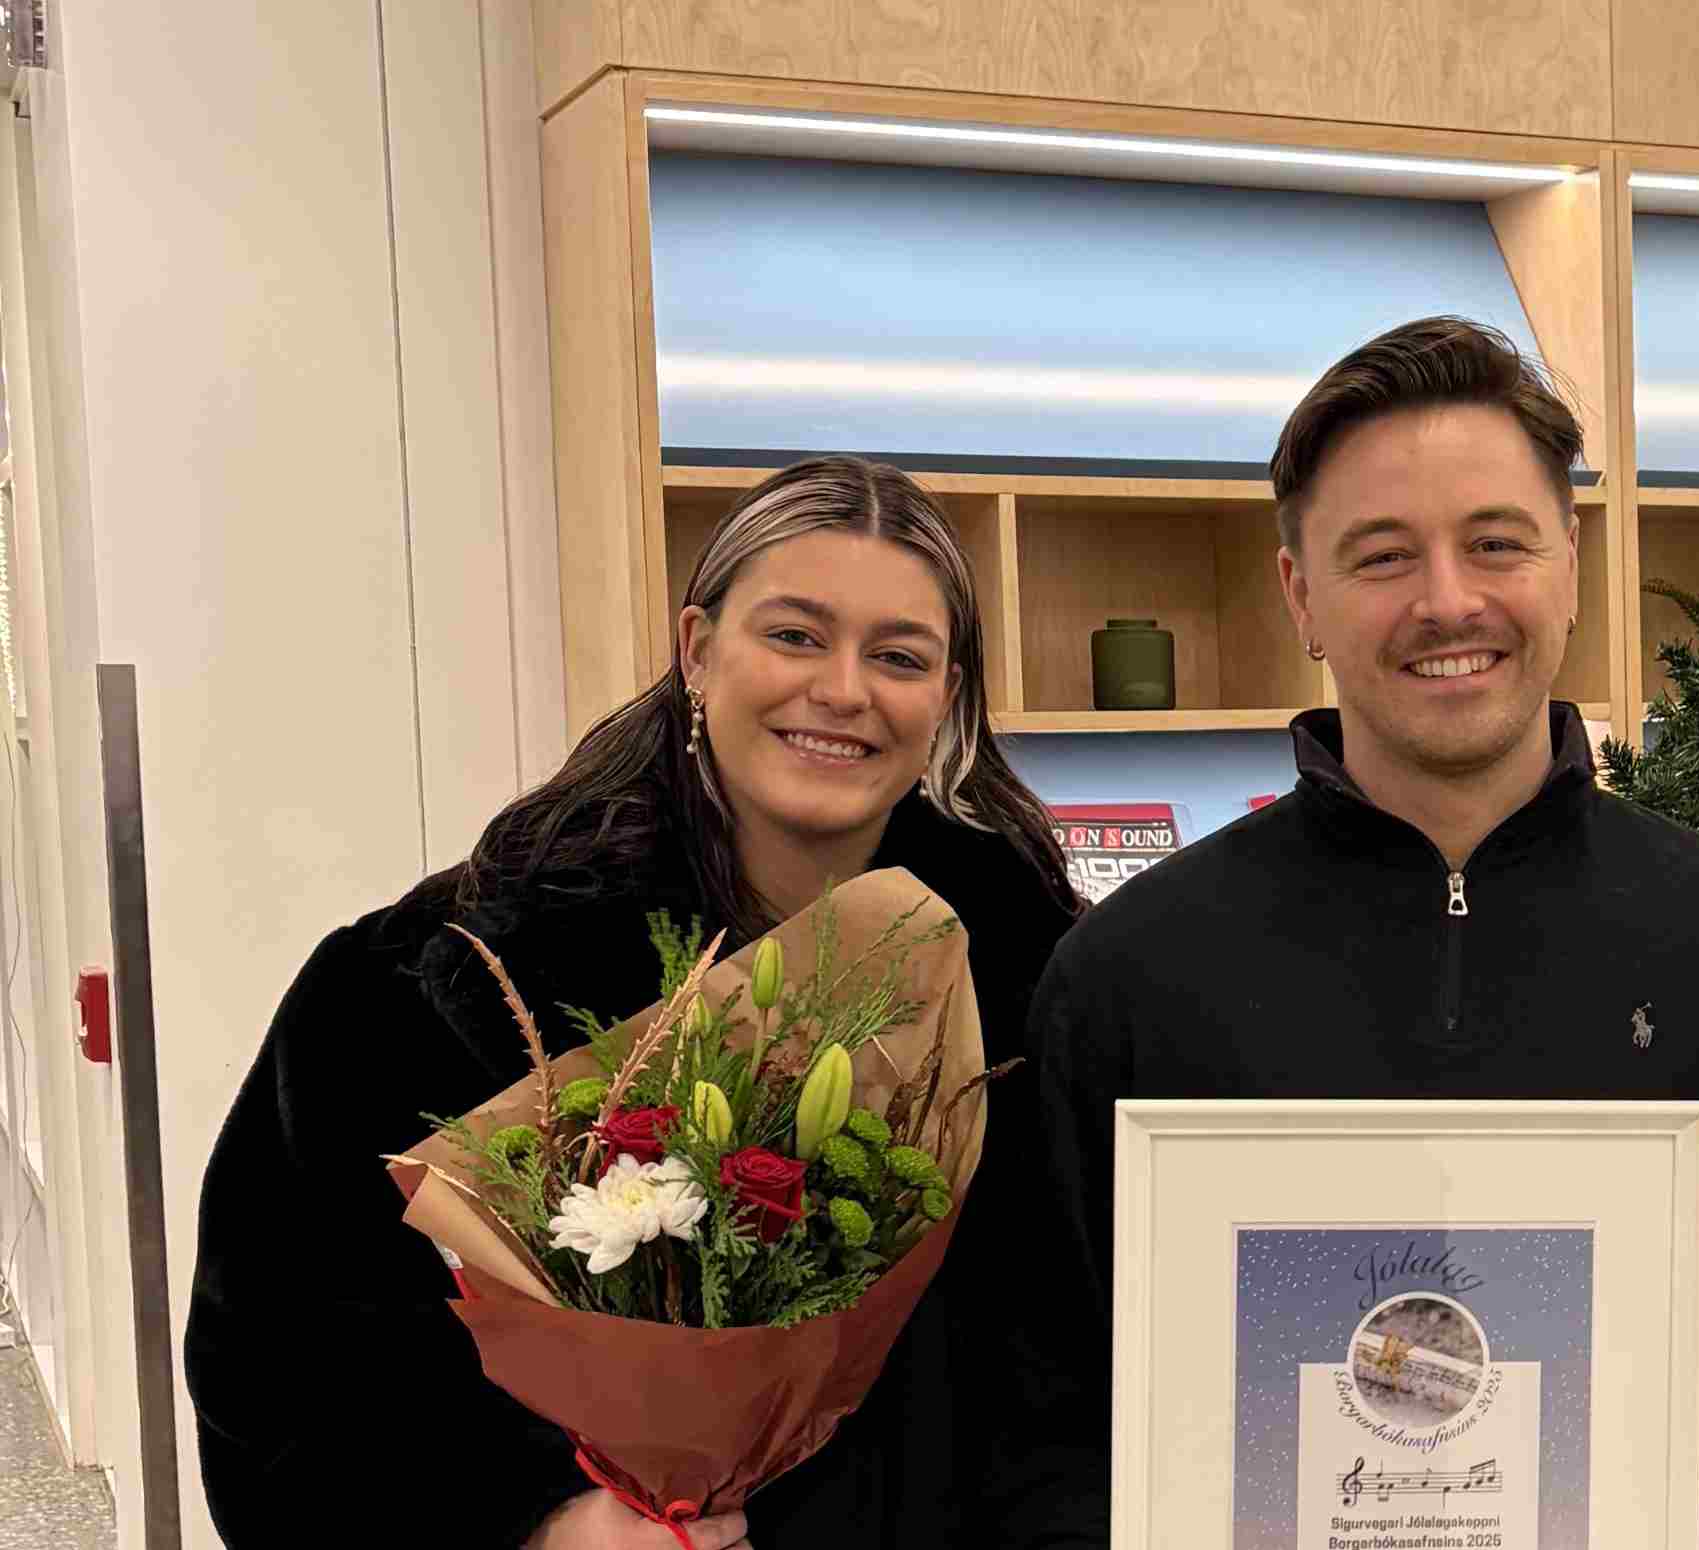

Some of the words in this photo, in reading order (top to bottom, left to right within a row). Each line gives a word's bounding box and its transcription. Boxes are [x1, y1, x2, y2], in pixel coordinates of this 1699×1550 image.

[1104, 827, 1173, 846] SOUND
[1330, 1516, 1403, 1533] Sigurvegari
[1406, 1515, 1501, 1531] Jólalagakeppni
[1466, 1533, 1502, 1549] 2025
